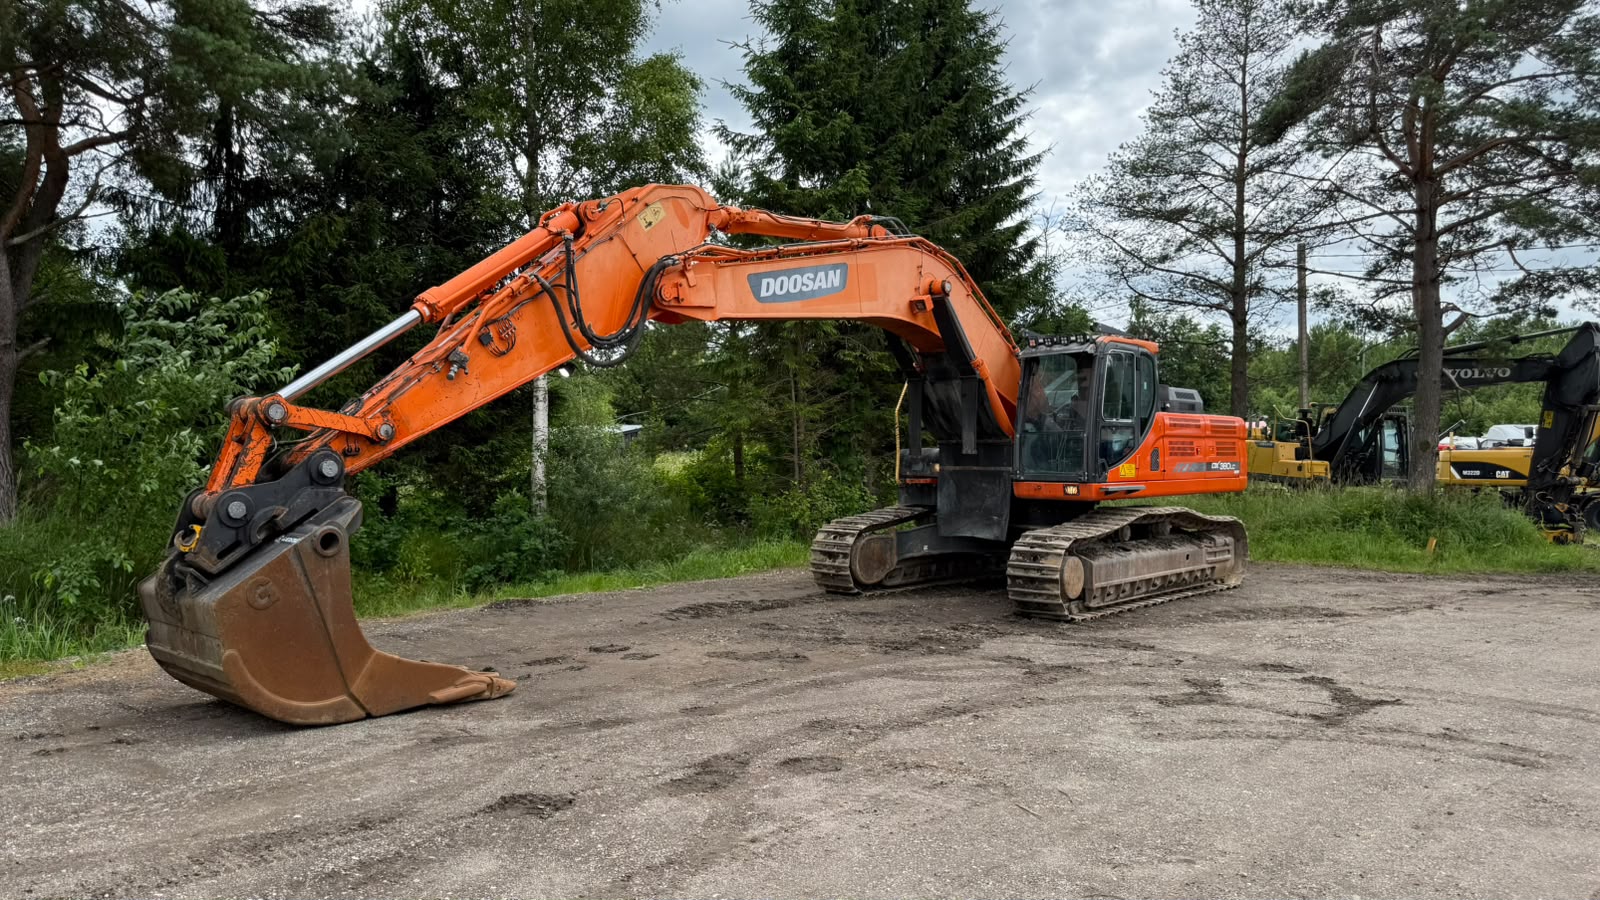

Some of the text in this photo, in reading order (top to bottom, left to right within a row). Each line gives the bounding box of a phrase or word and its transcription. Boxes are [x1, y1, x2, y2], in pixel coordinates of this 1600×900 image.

[760, 269, 841, 297] DOOSAN
[1446, 367, 1511, 379] VOLVO
[1495, 470, 1511, 479] CAT
